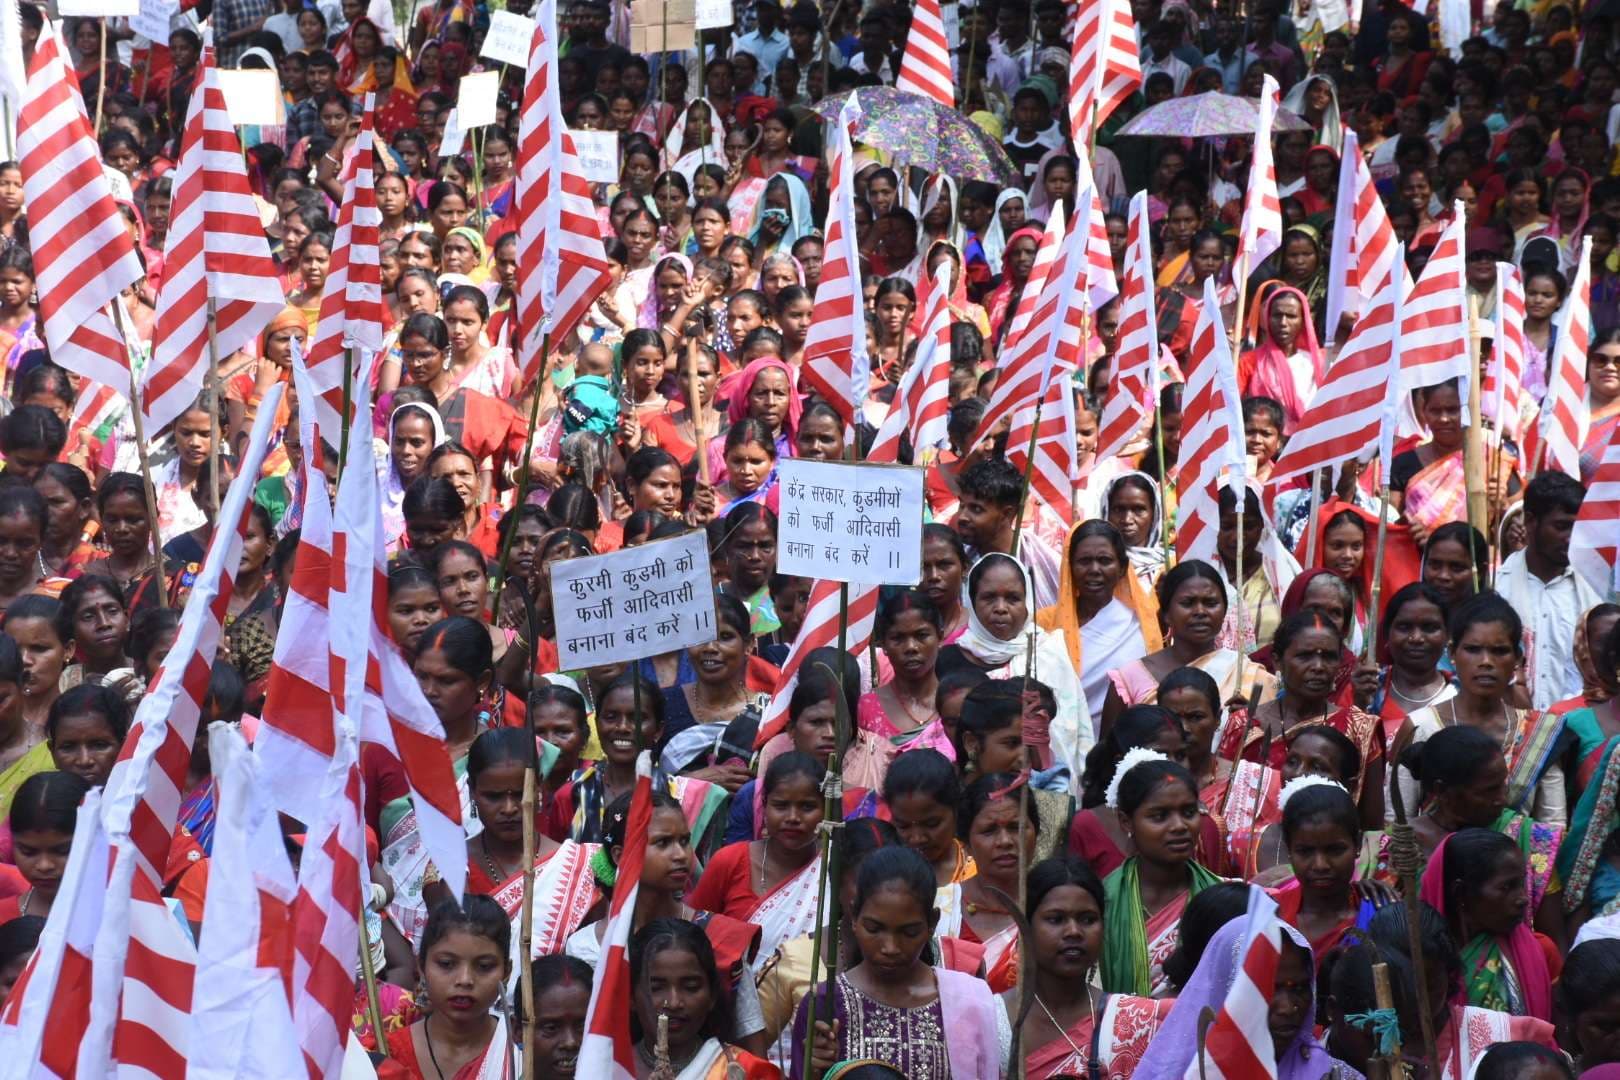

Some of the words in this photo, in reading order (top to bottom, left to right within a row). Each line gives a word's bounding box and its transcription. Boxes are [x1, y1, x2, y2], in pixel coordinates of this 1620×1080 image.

[811, 486, 846, 508] सरकार,
[787, 506, 800, 528] को
[812, 511, 834, 533] फर्जी
[846, 515, 901, 538] आदिवासी
[786, 541, 815, 560] बनाना
[824, 542, 840, 563] बंद
[850, 543, 871, 566] करें
[567, 568, 612, 600] कुरमी
[621, 557, 665, 591] कुडमी
[674, 549, 693, 572] को
[576, 595, 613, 623] फर्जी
[623, 580, 694, 614] आदिवासी
[566, 632, 615, 654] बनाना
[624, 623, 647, 644] बंद
[656, 613, 680, 637] करें
